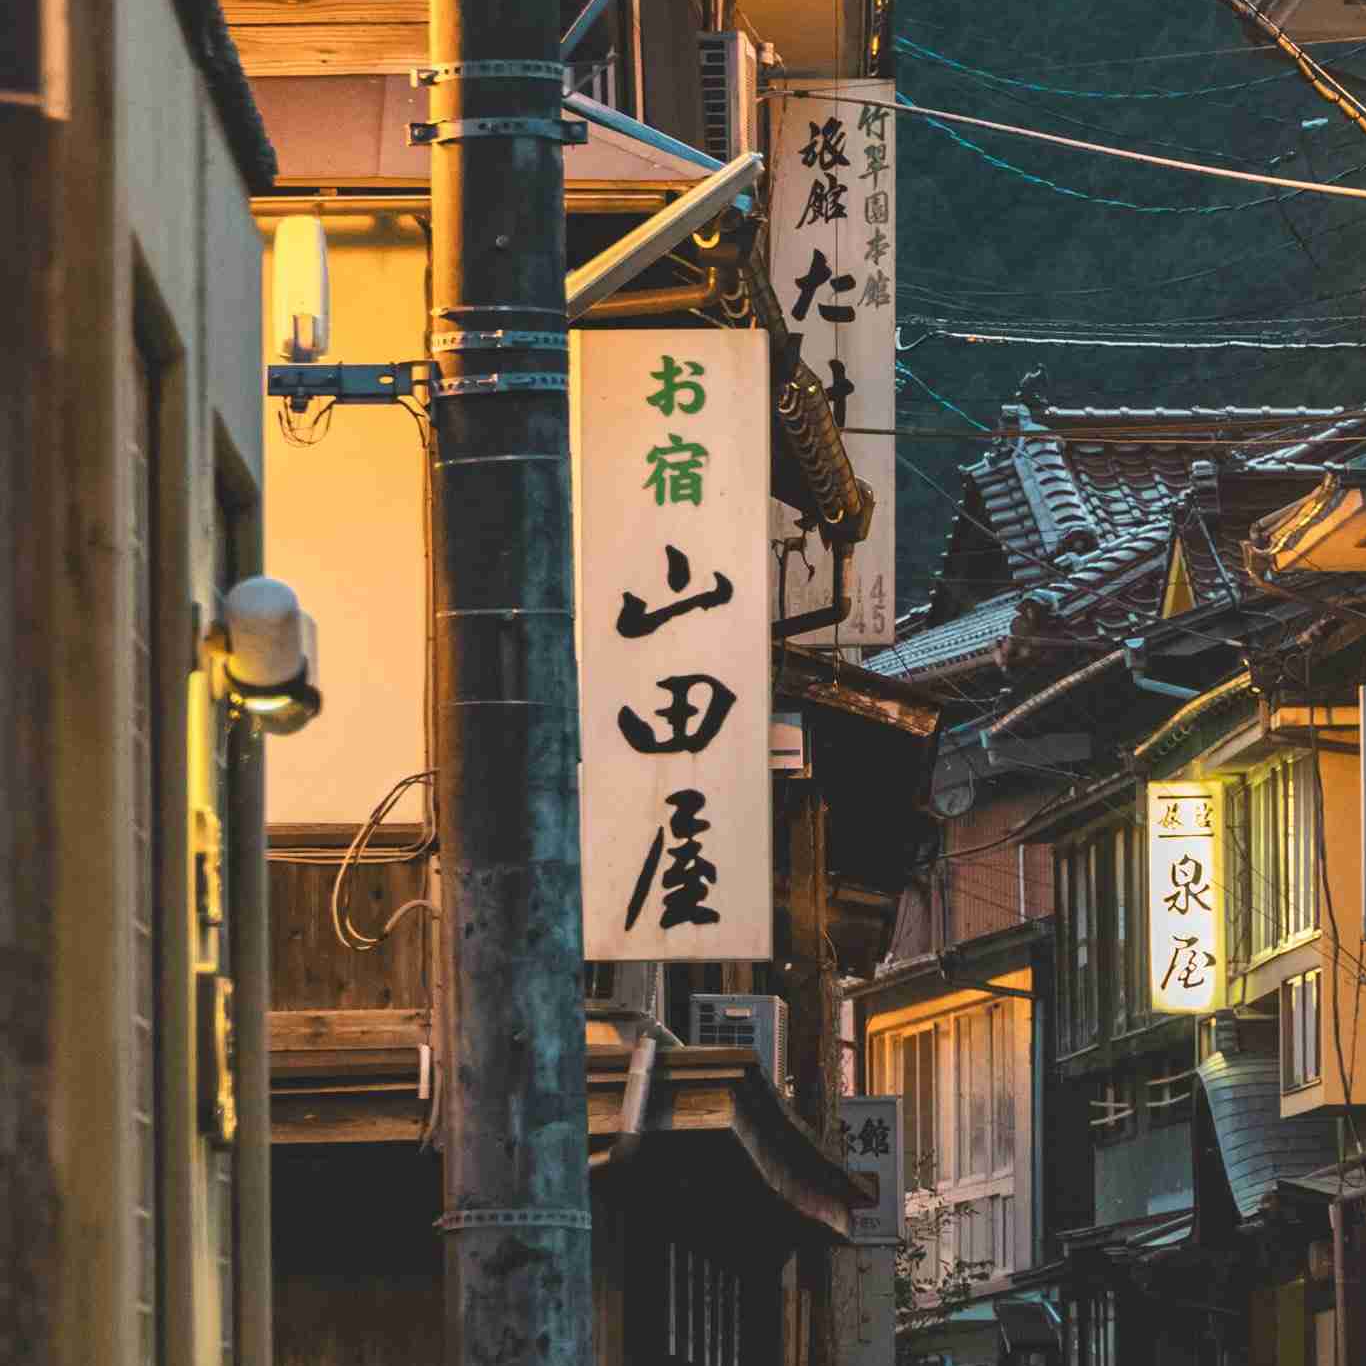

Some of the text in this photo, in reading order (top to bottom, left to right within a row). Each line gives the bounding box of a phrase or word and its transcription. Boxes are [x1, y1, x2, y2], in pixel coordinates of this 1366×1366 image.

[795, 116, 850, 230] 旅館
[616, 354, 736, 932] お宿 山田屋
[1161, 854, 1217, 991] 泉屋
